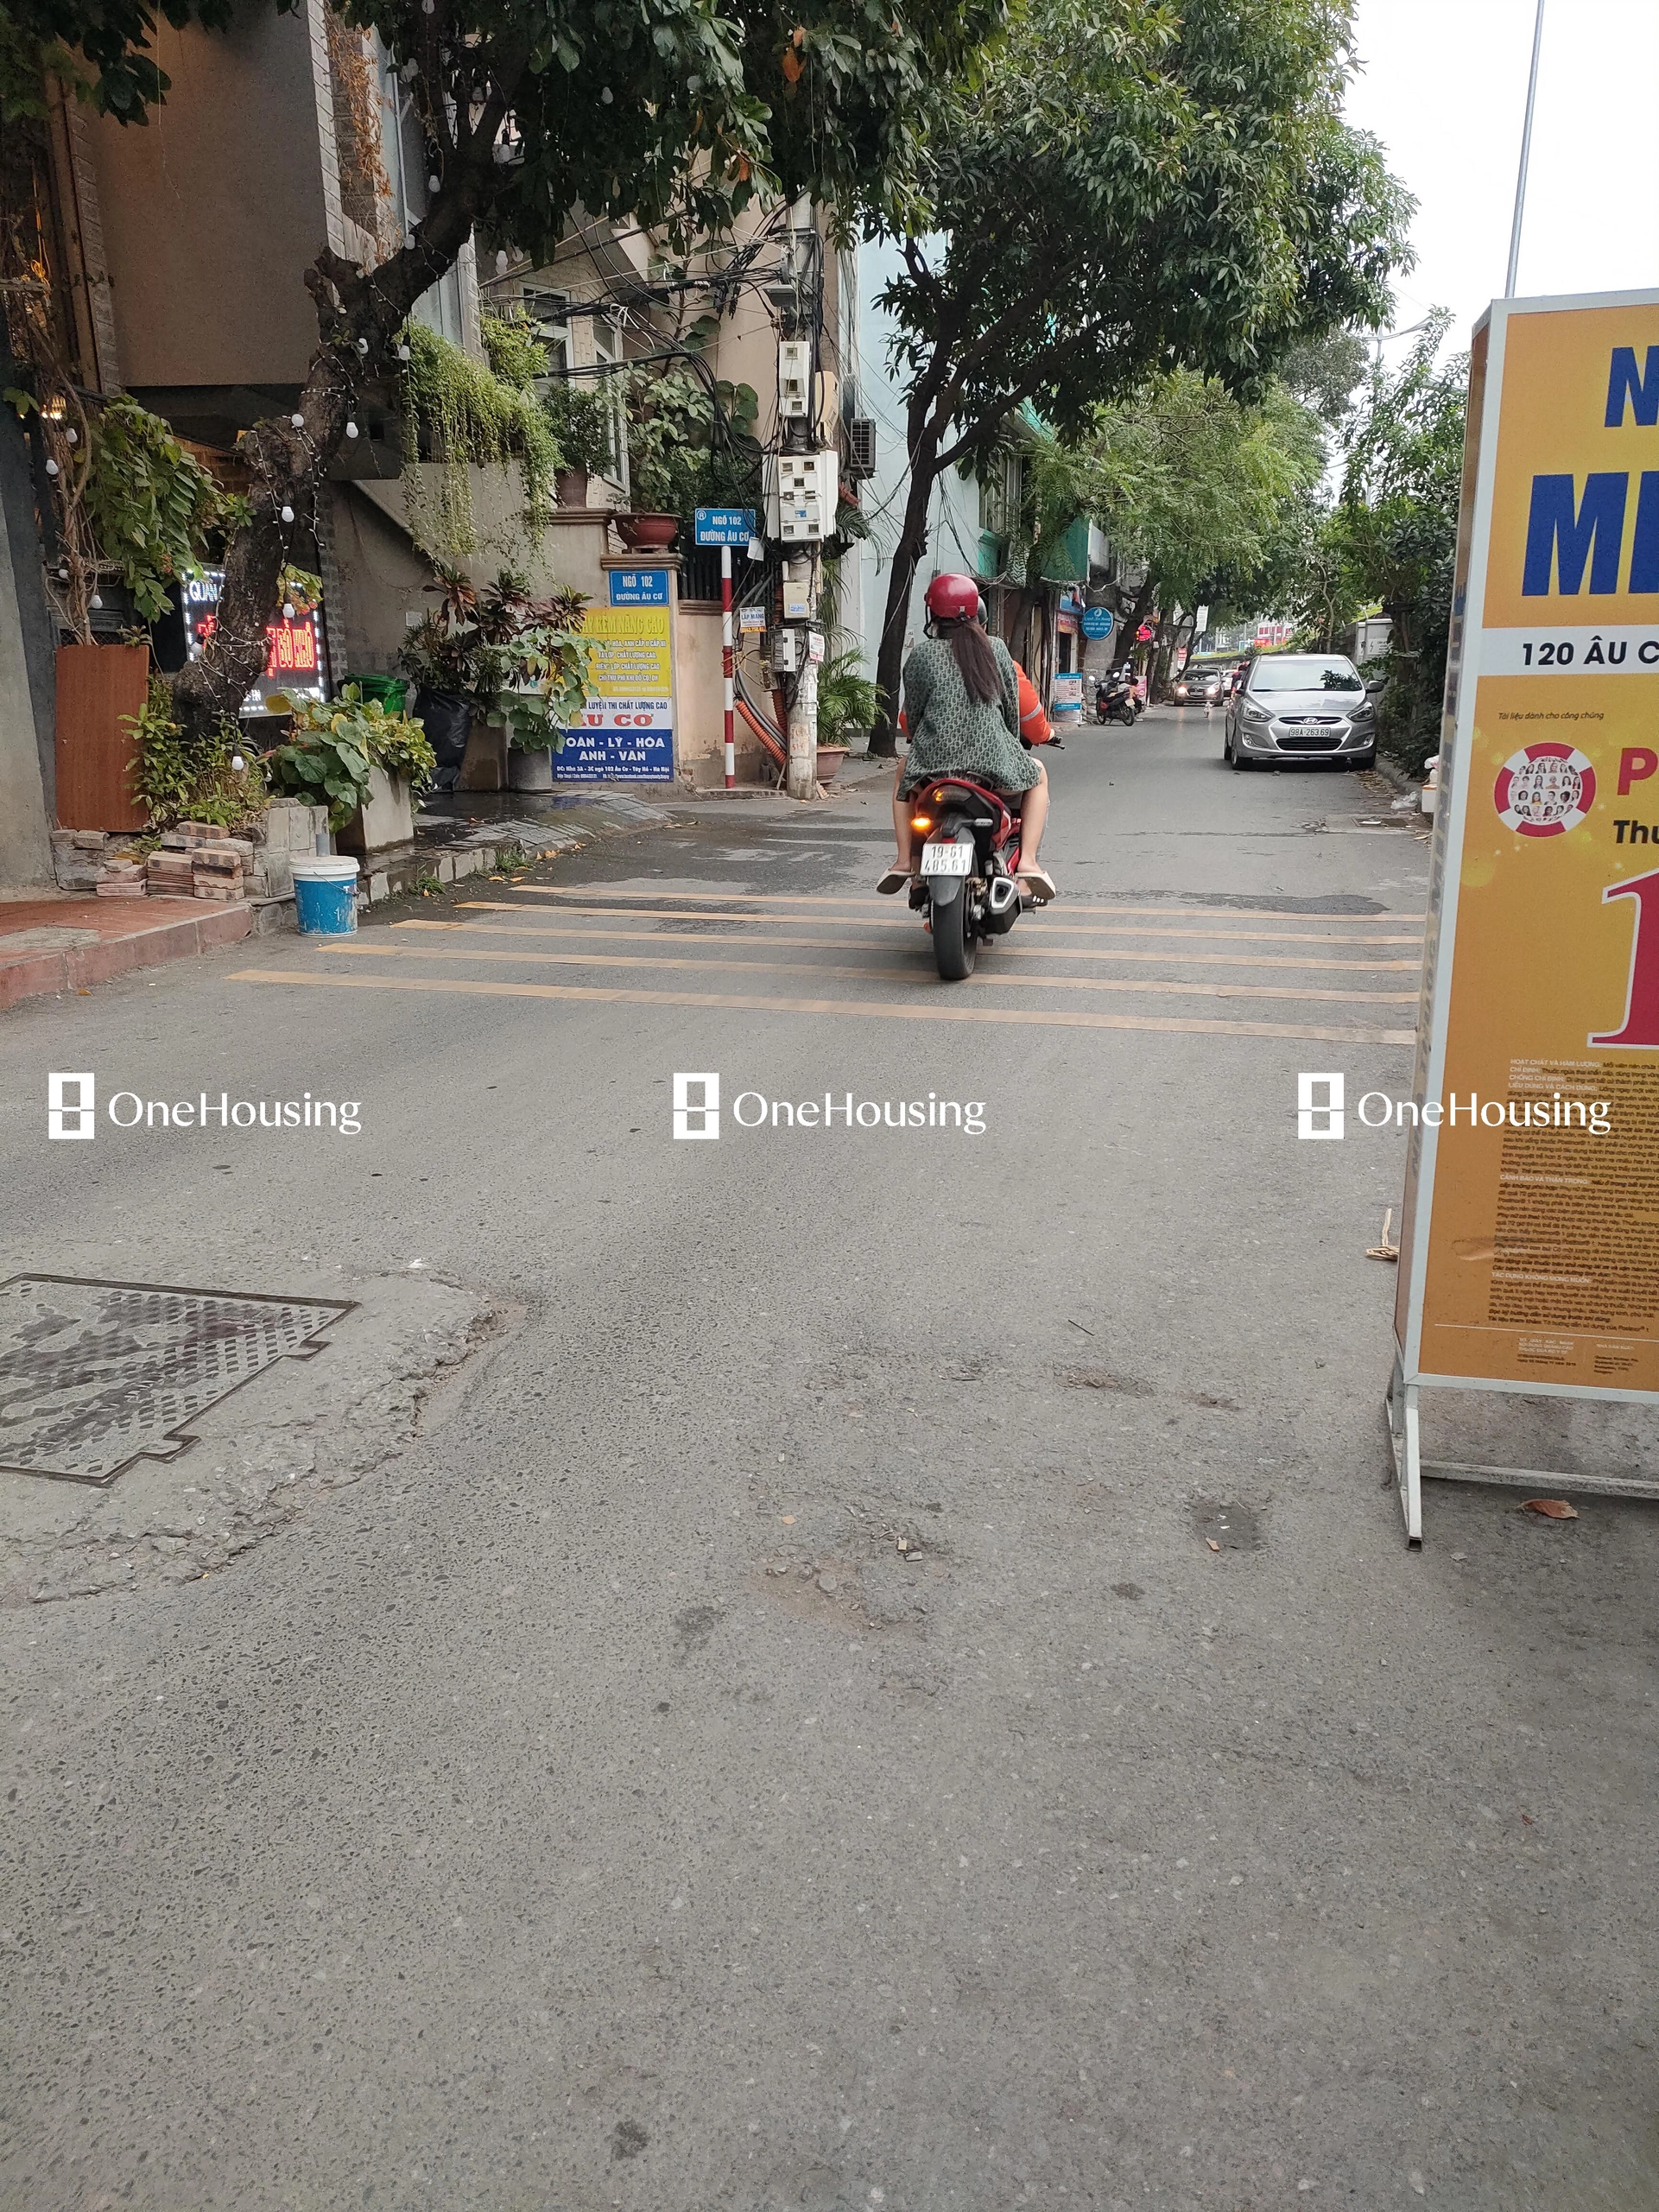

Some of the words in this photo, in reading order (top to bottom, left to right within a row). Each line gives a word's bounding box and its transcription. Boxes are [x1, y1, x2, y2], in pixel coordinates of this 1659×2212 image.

[712, 515, 727, 525] NGÕ
[729, 516, 742, 525] 102
[700, 529, 725, 542] ĐƯỜNG
[727, 529, 737, 542] ÂU
[738, 531, 750, 542] CƠ
[622, 574, 636, 587] NGÕ
[641, 575, 653, 587] 102
[616, 591, 640, 600] ĐƯỜNG
[642, 591, 651, 600] ÂU
[646, 616, 665, 634] CAO
[1523, 642, 1574, 666] 120
[1583, 635, 1627, 665] ÂU
[618, 700, 634, 710] CHẤT
[635, 701, 654, 711] LƯỢNG
[613, 713, 654, 727] CƠ
[579, 751, 606, 761] ANH
